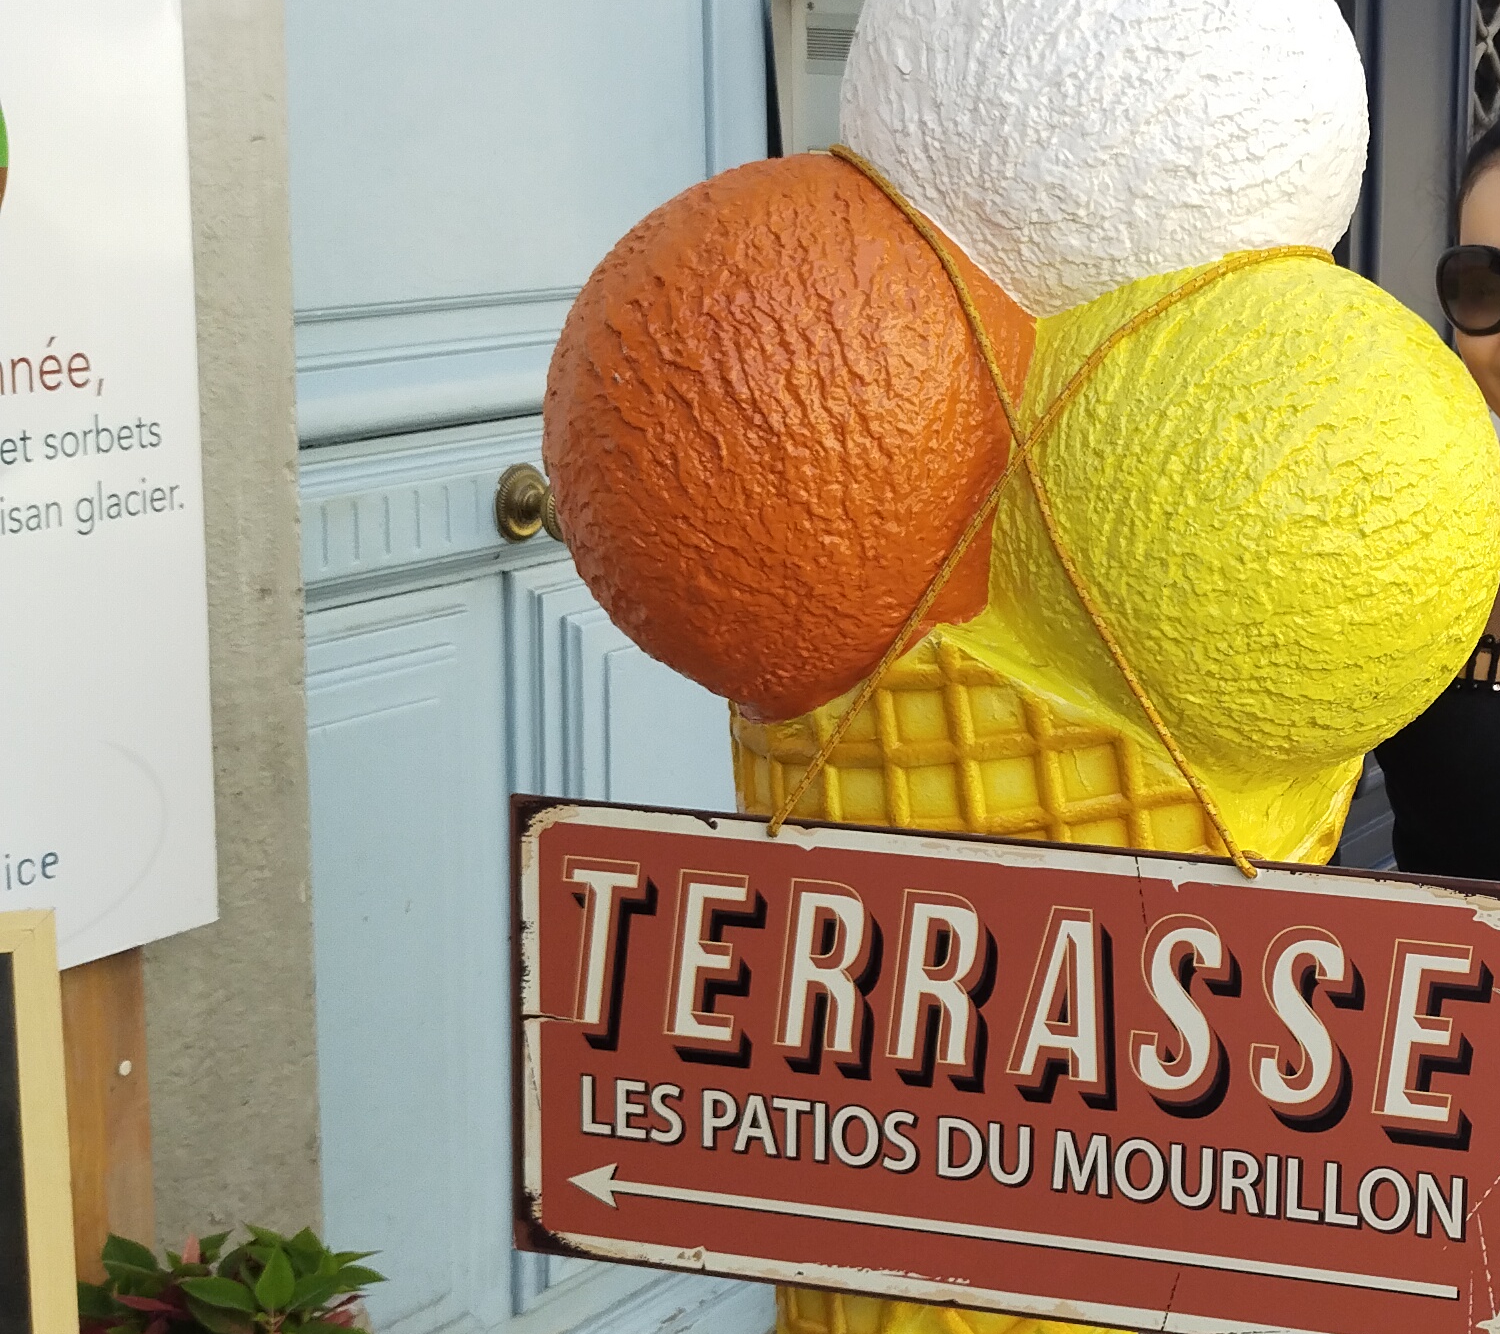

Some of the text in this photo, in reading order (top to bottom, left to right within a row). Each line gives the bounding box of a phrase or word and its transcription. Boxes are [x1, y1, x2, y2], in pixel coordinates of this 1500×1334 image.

[0, 413, 162, 466] et sorbets
[75, 477, 185, 536] glacier.
[563, 855, 1494, 1151] TERRASSE
[580, 1072, 1468, 1242] LES PATIOS DU MOURILLON
